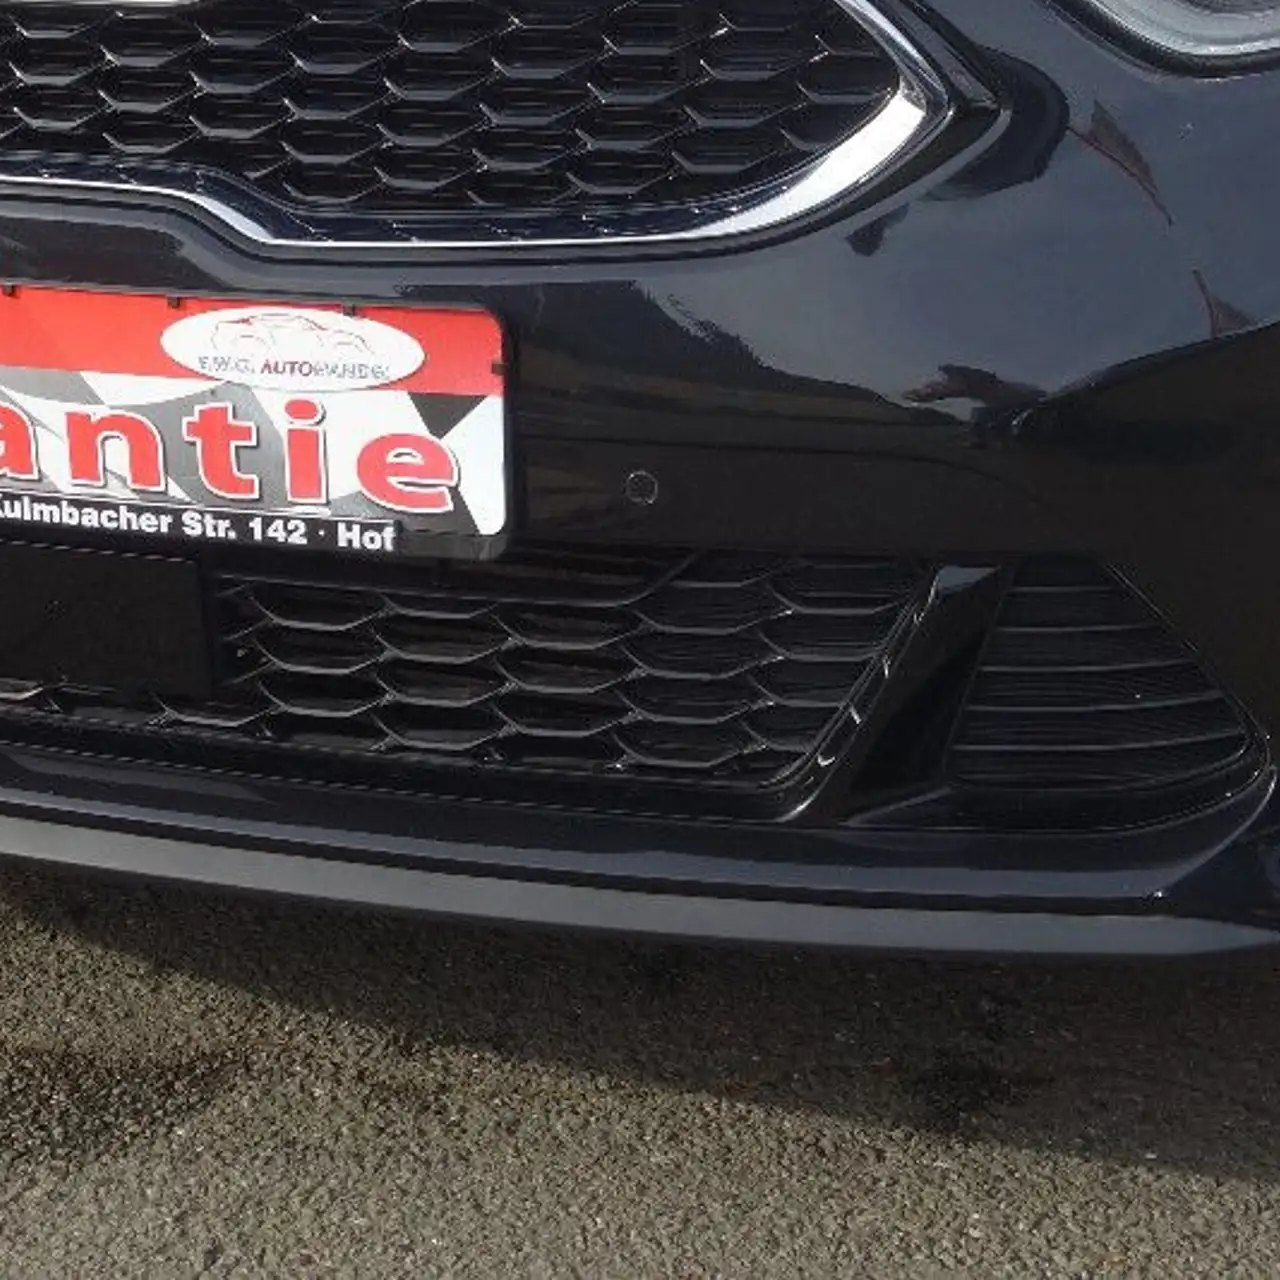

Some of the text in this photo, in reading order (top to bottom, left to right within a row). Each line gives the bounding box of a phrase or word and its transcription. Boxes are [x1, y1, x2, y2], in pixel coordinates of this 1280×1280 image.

[181, 510, 237, 540] Str.
[250, 517, 308, 546] 142
[337, 521, 397, 552] Hof
